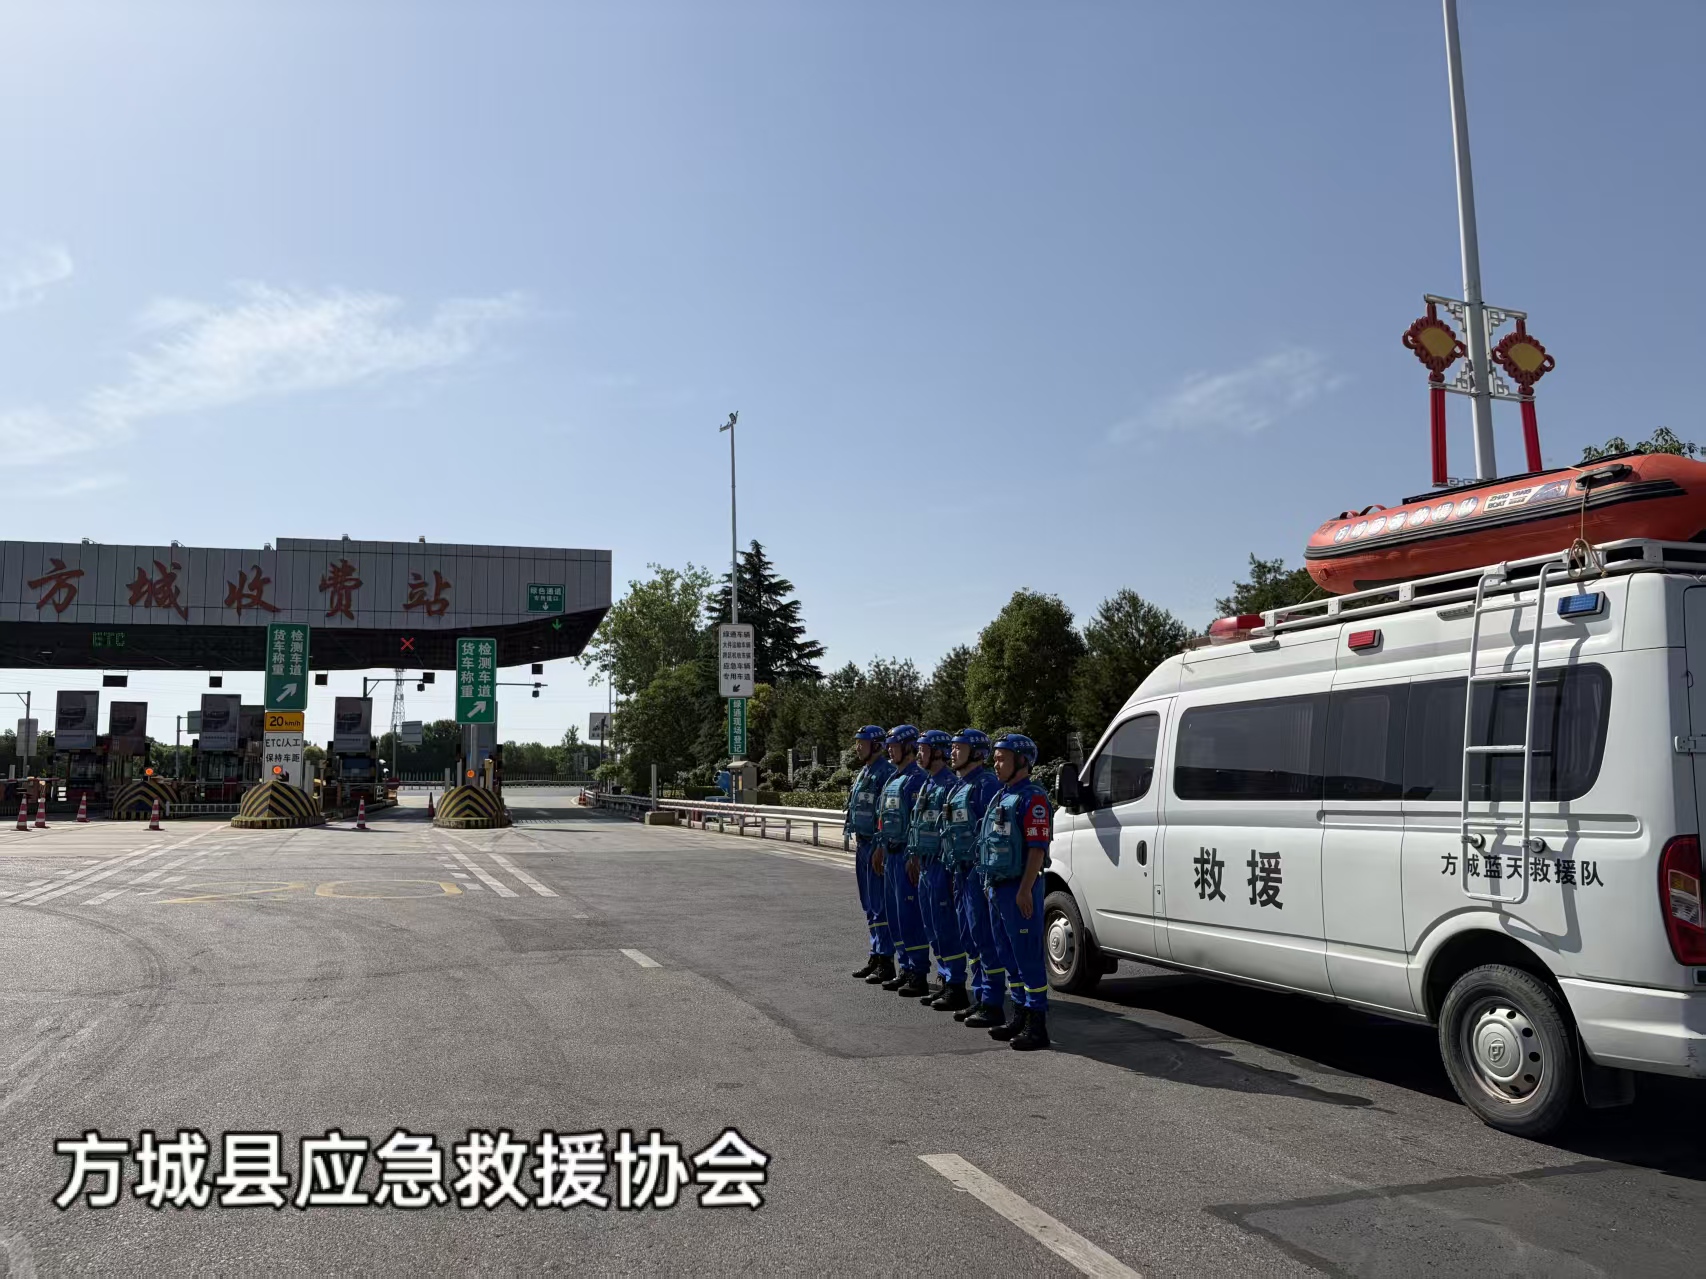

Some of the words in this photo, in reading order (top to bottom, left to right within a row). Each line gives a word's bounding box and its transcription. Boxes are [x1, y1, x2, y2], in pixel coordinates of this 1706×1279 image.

[28, 558, 452, 621] 方城收费站
[92, 631, 126, 647] ETC
[271, 629, 287, 676] 货车称重
[289, 629, 304, 676] 检测车道
[460, 642, 475, 698] 货车称重
[477, 642, 492, 698] 检测车道
[723, 662, 751, 670] 应急车辆
[723, 672, 751, 680] 专用车道
[269, 716, 284, 727] 20
[284, 719, 301, 727] km/h
[265, 738, 301, 748] ETC/人工
[265, 753, 301, 763] 保持车距
[1193, 846, 1284, 910] 救援
